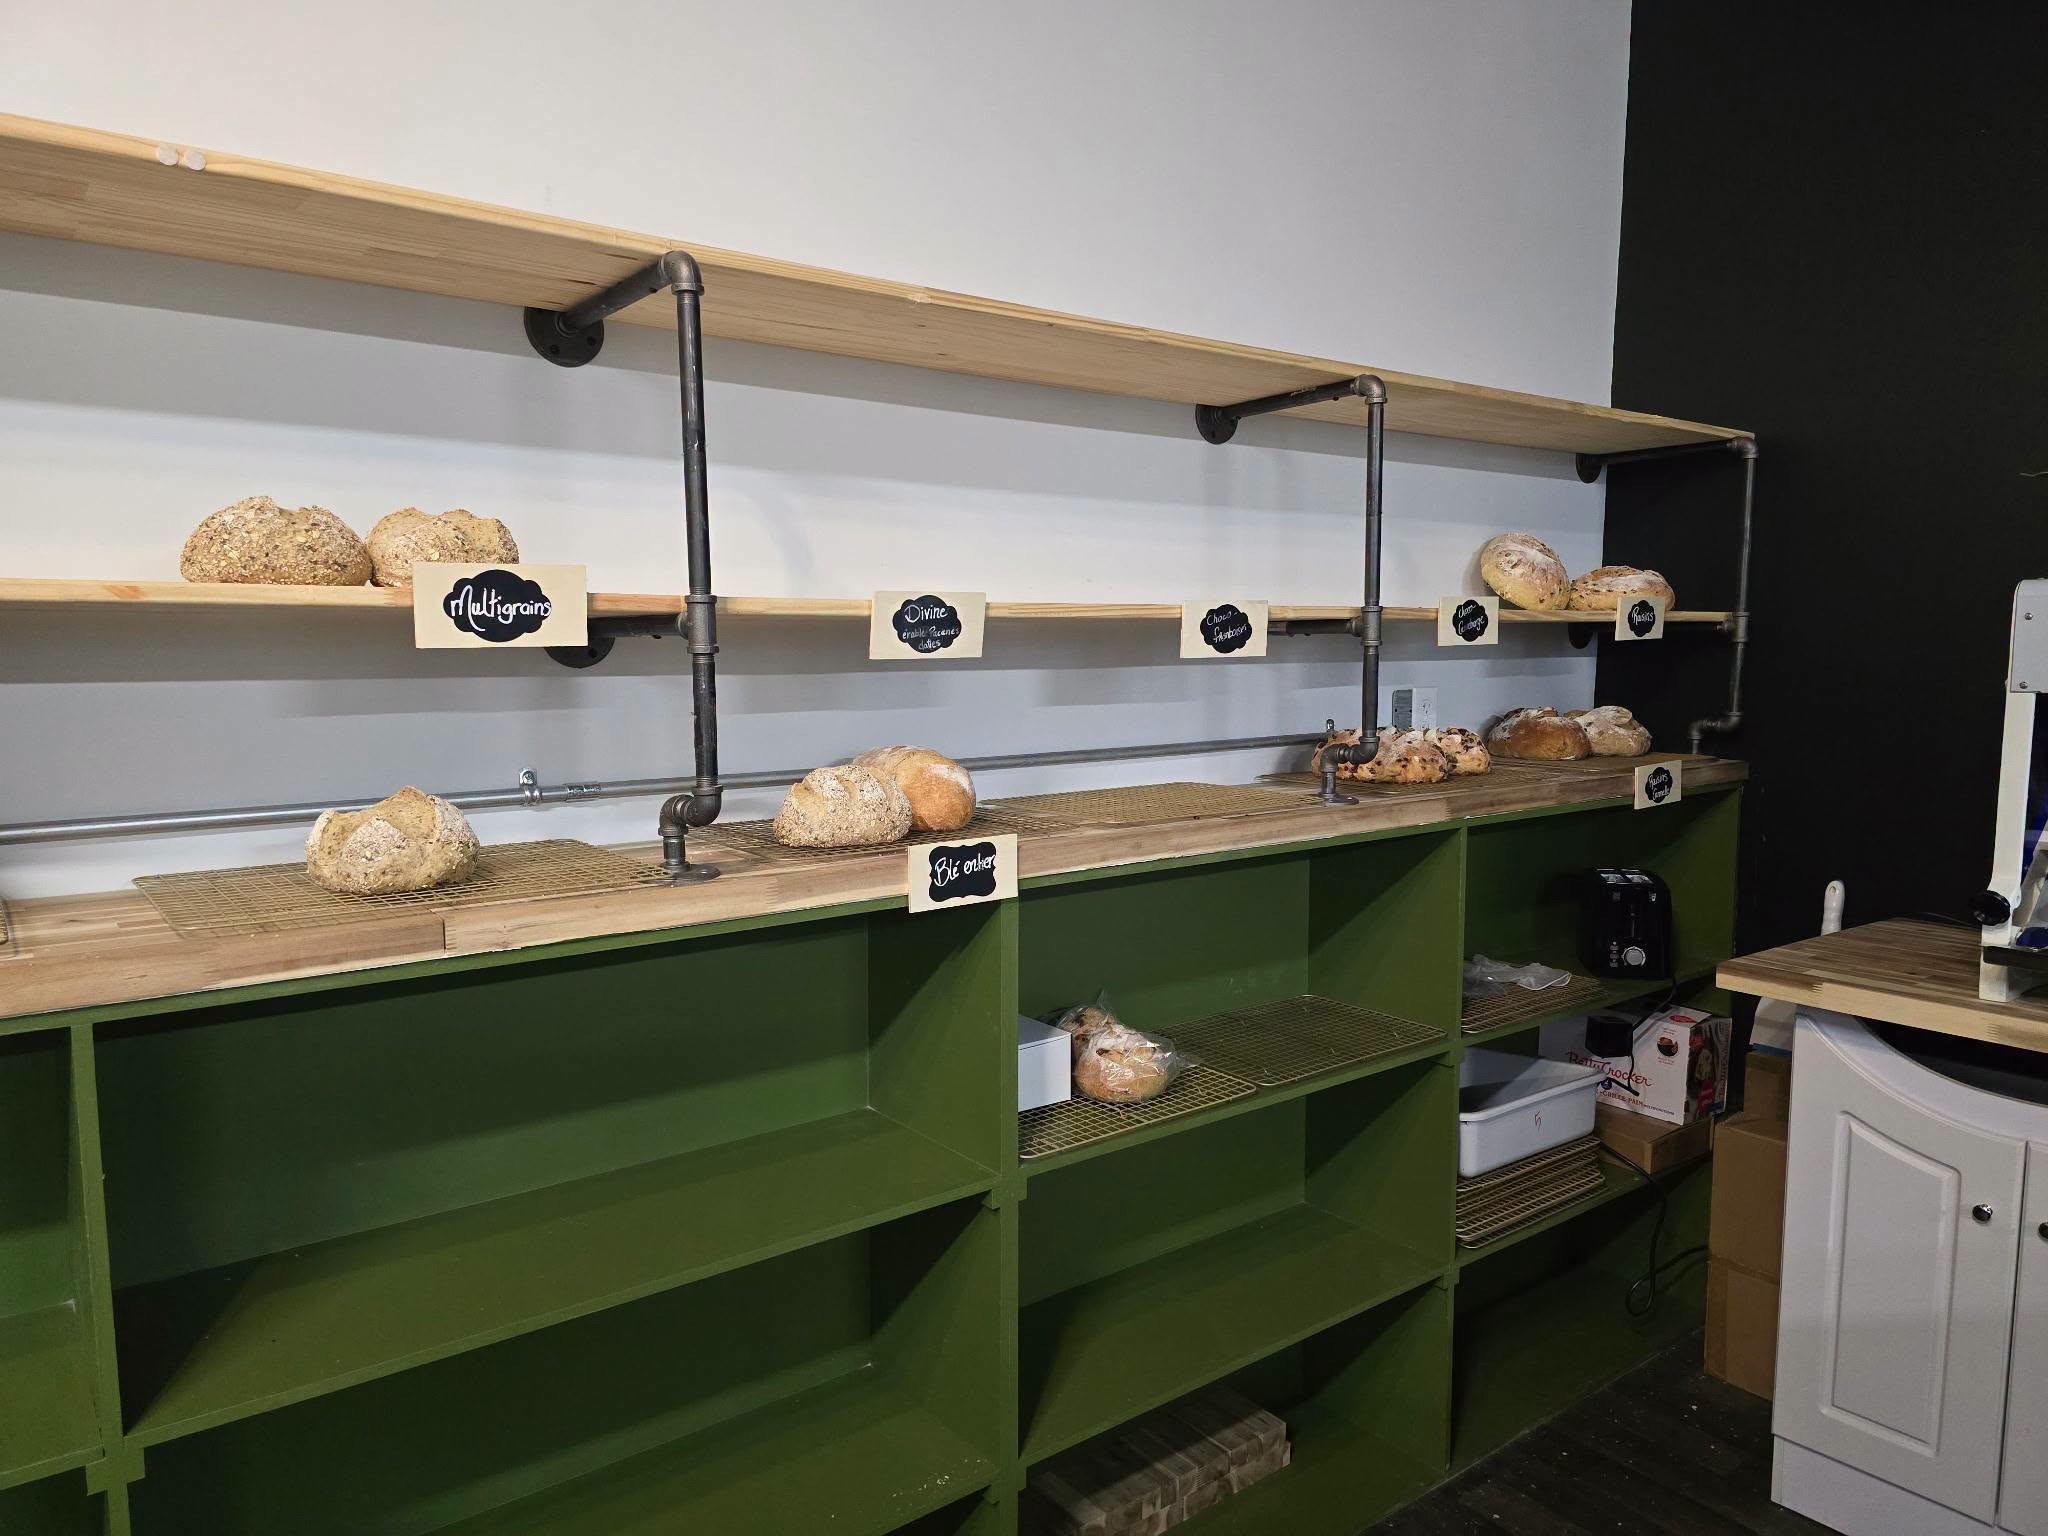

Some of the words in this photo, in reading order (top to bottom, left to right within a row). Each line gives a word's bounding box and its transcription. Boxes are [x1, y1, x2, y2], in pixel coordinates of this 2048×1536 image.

[450, 585, 552, 632] Multigrains
[904, 605, 948, 623] Divine
[934, 856, 961, 887] Blé
[963, 853, 996, 875] entier
